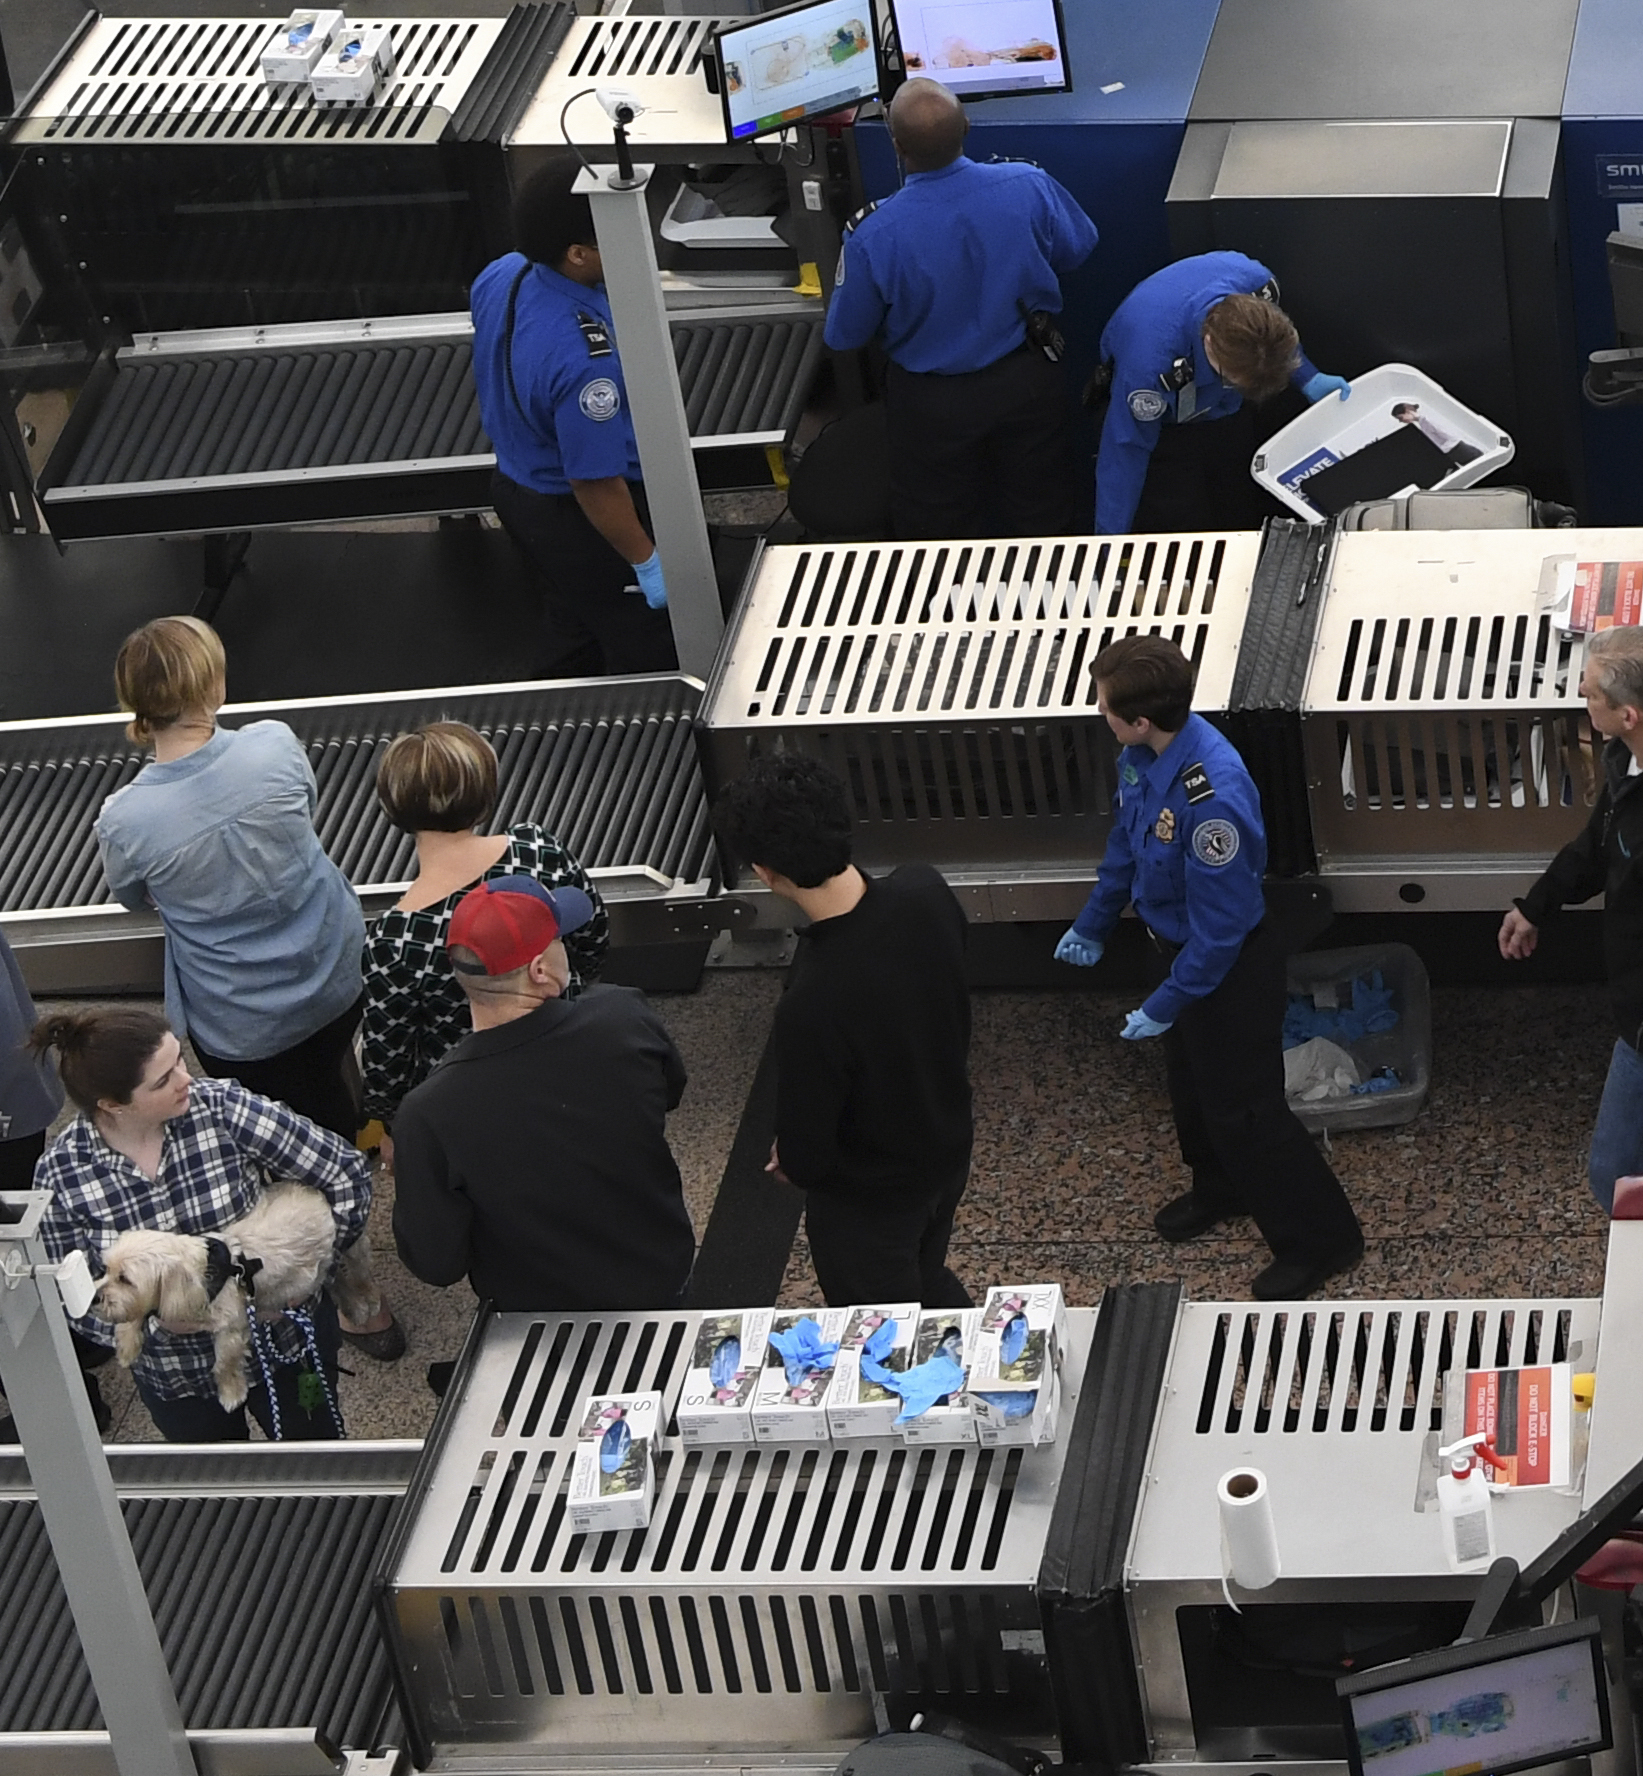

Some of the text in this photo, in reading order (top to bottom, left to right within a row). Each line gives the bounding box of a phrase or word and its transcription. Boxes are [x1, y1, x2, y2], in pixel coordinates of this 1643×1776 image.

[587, 333, 606, 344] TSA
[1184, 775, 1207, 793] TSA
[1487, 1373, 1496, 1383] DO
[686, 1395, 704, 1405] S
[760, 1392, 780, 1406] M
[634, 1400, 651, 1411] S
[1528, 1384, 1539, 1467] DO NOT BLOCK E-STOP
